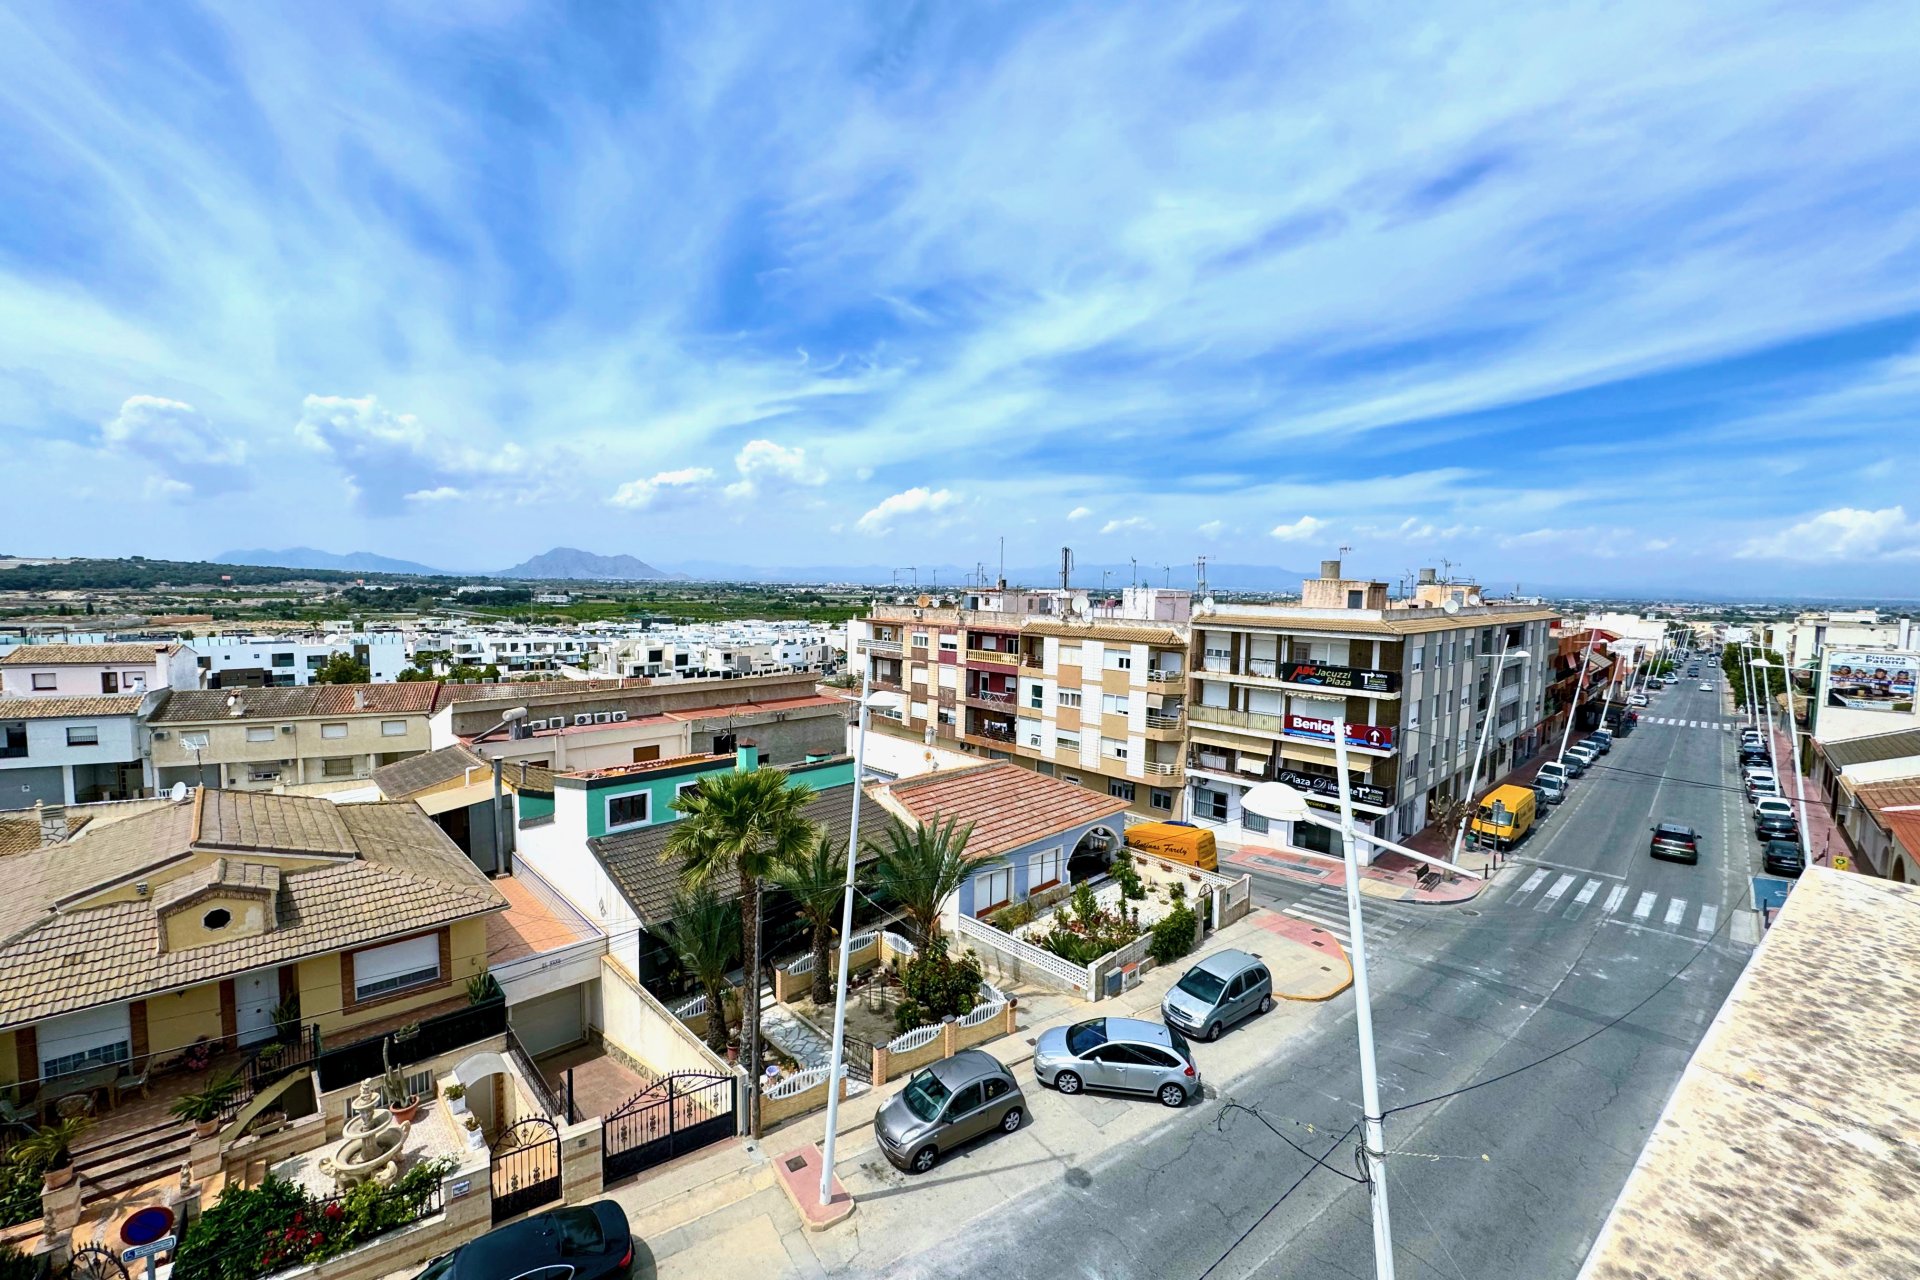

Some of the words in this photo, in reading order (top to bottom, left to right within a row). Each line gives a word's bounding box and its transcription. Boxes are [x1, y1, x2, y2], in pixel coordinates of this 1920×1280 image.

[1315, 668, 1352, 680] Jacuzzi
[1325, 677, 1352, 687] Plaza
[1280, 771, 1311, 786] Plaza
